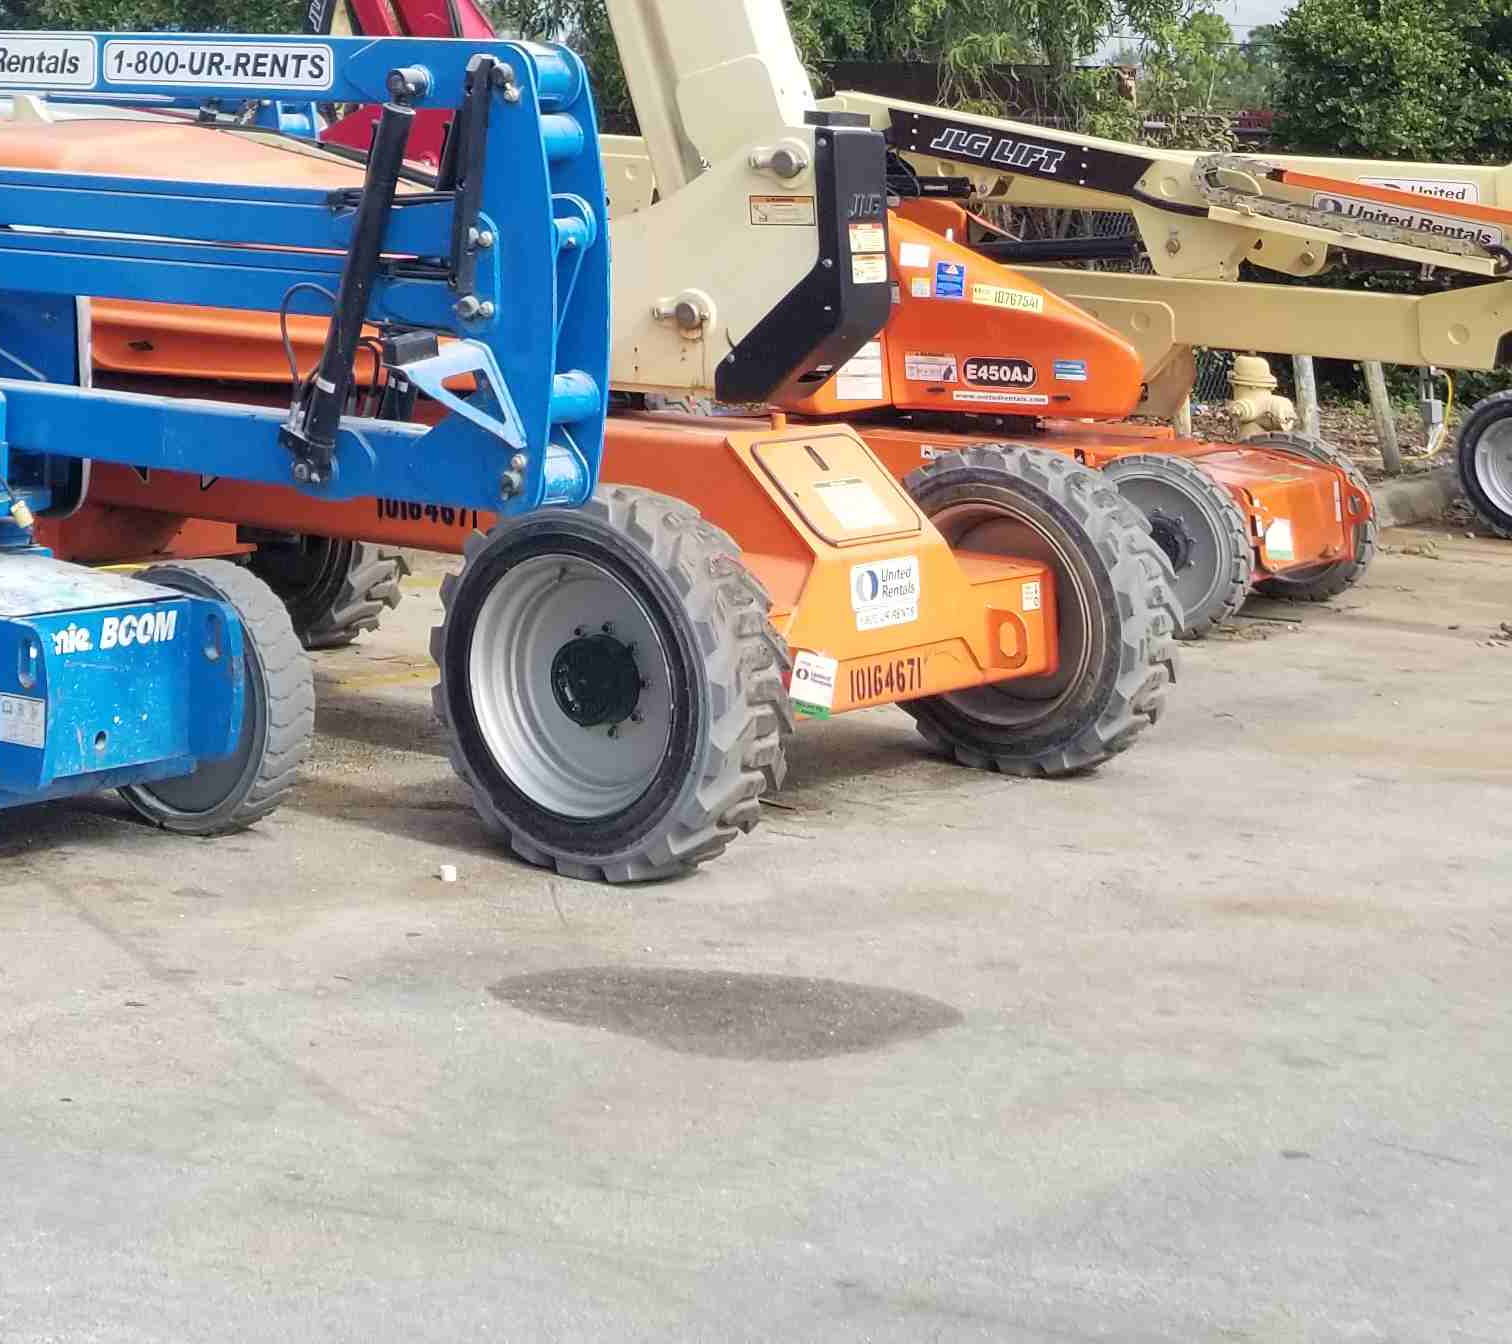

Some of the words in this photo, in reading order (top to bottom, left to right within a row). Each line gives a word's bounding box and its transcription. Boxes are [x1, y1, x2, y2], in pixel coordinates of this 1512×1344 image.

[114, 49, 325, 80] 1-800-UR-RENTS
[930, 128, 992, 158] JLG
[991, 139, 1066, 173] LIFT
[1347, 203, 1414, 229] United
[1418, 217, 1492, 245] Rentals
[964, 363, 1035, 383] E450AJ
[881, 564, 912, 582] United
[881, 581, 915, 599] Rentals
[850, 656, 922, 703] 10164671
